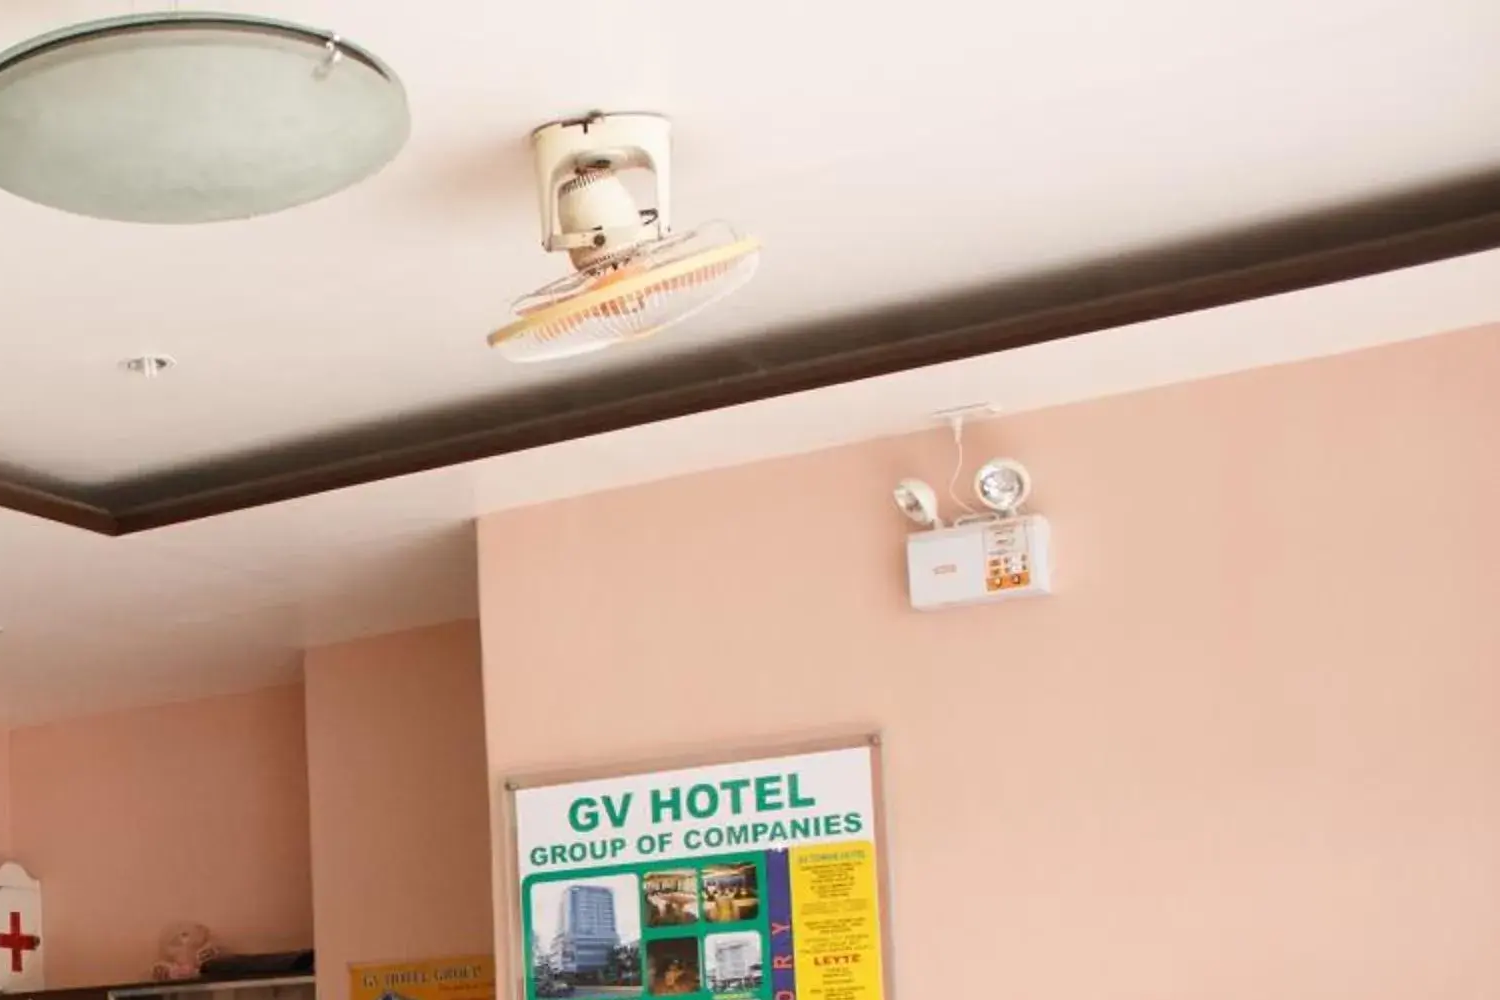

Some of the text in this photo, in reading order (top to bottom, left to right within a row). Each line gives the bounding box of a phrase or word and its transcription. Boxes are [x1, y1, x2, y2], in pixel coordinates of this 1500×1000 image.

[567, 772, 817, 833] GV HOTEL
[529, 811, 863, 867] GROUP OF COMPANIES
